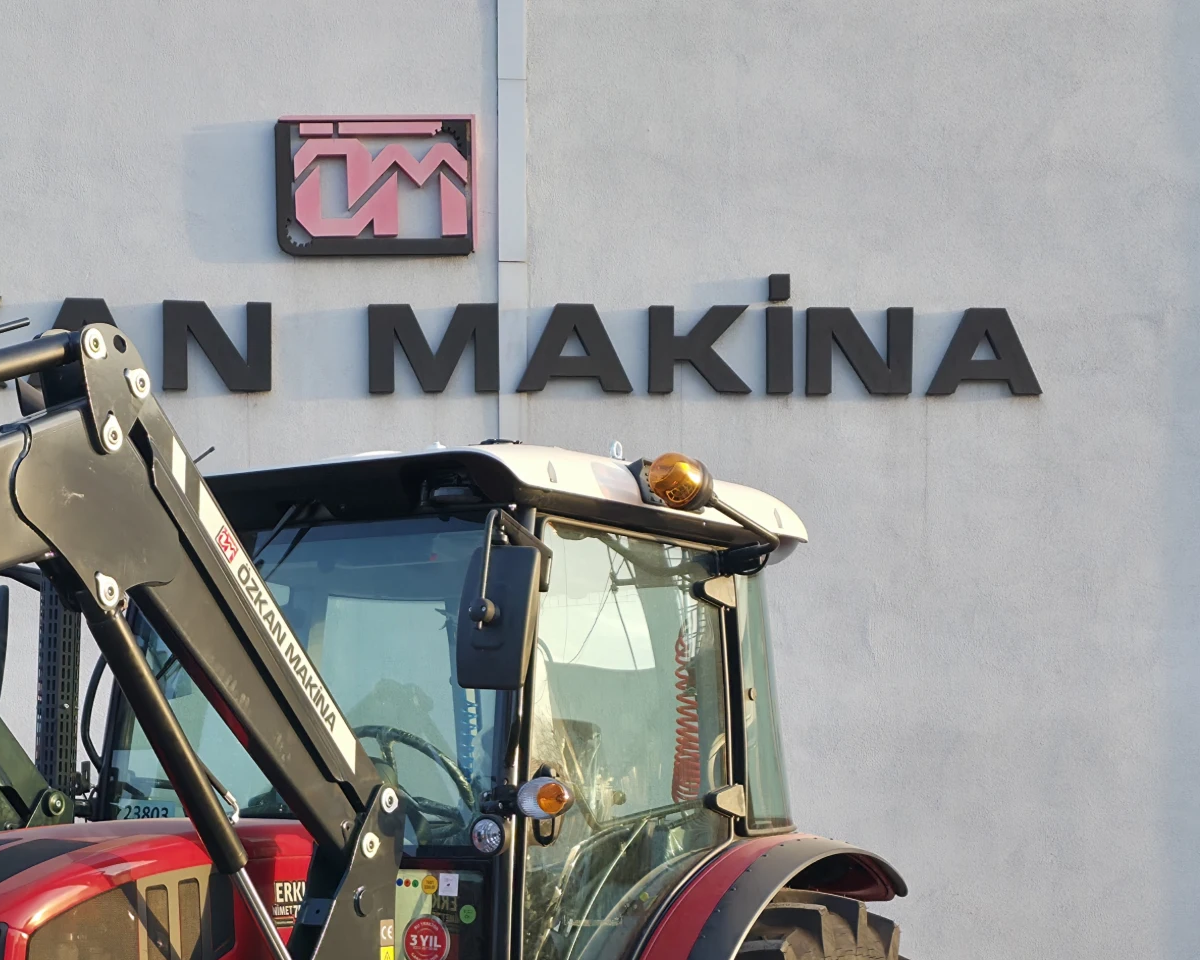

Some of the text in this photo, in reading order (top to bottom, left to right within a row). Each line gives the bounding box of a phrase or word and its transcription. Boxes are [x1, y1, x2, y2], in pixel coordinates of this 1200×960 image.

[367, 274, 1042, 395] MAKİNA
[237, 562, 336, 732] ÖZKAN MAKİNA
[124, 805, 169, 819] 23803
[409, 934, 418, 946] 3
[419, 934, 442, 948] YIL
